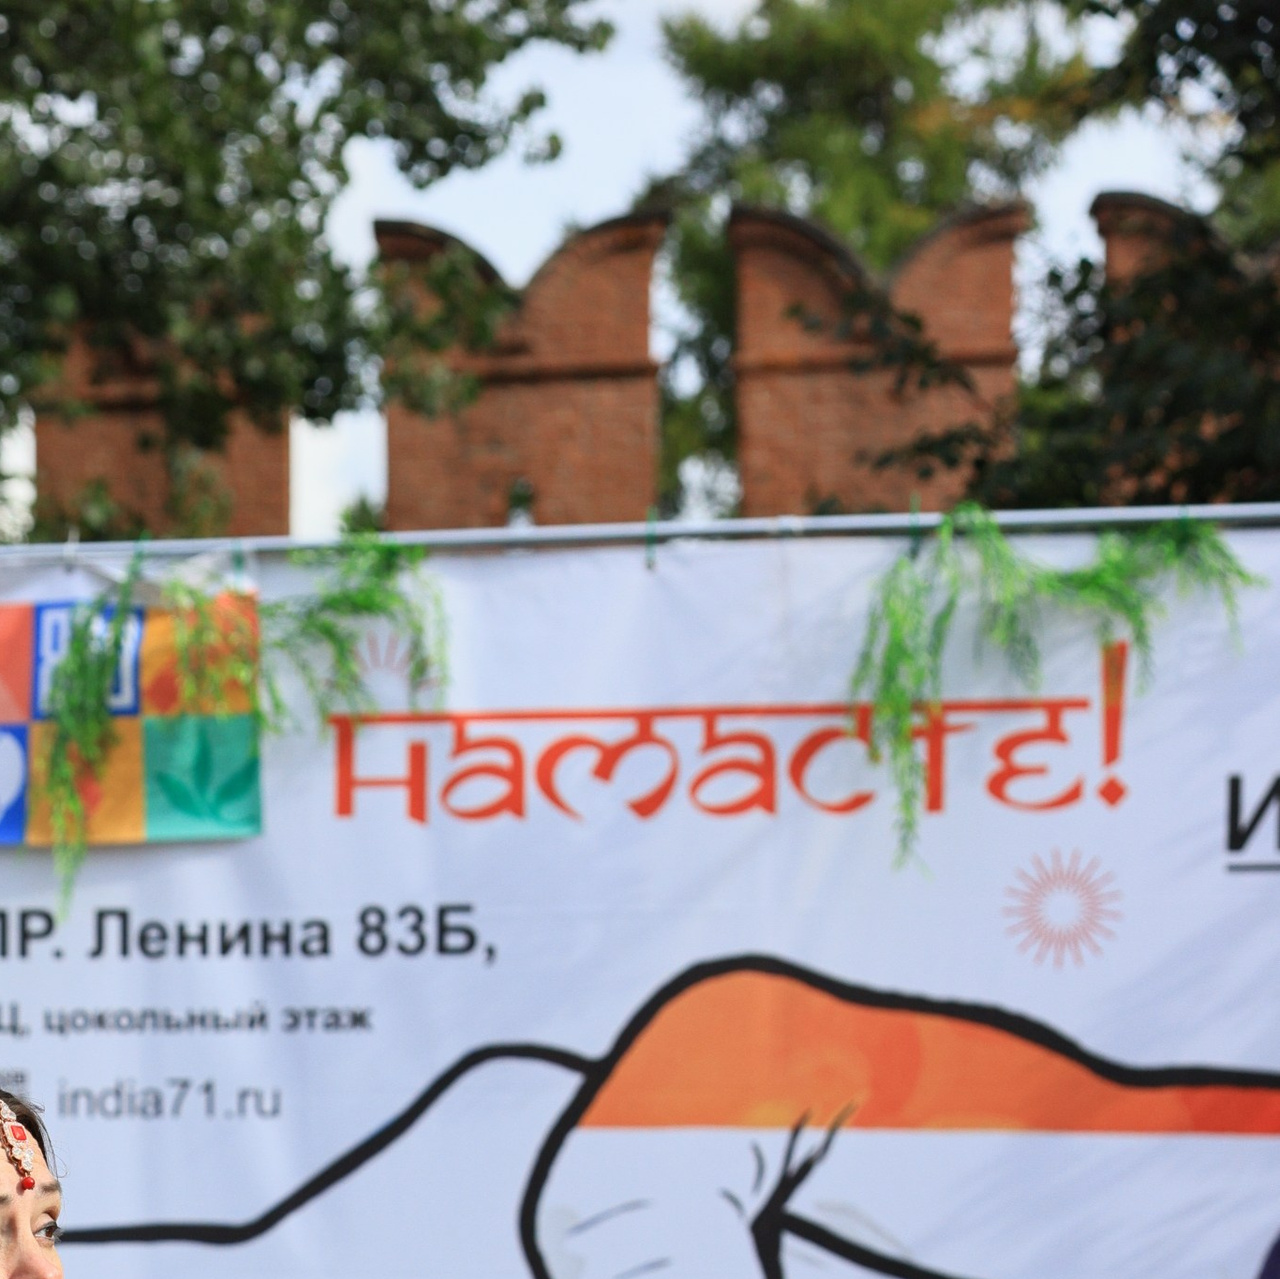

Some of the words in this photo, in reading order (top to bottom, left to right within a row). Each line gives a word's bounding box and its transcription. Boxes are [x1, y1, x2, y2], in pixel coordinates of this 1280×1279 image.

[87, 908, 333, 961] Ленина
[355, 903, 499, 965] 83Б,
[43, 1002, 269, 1039] цокольный
[282, 1007, 374, 1034] этаж
[57, 1077, 282, 1119] india71.ru
